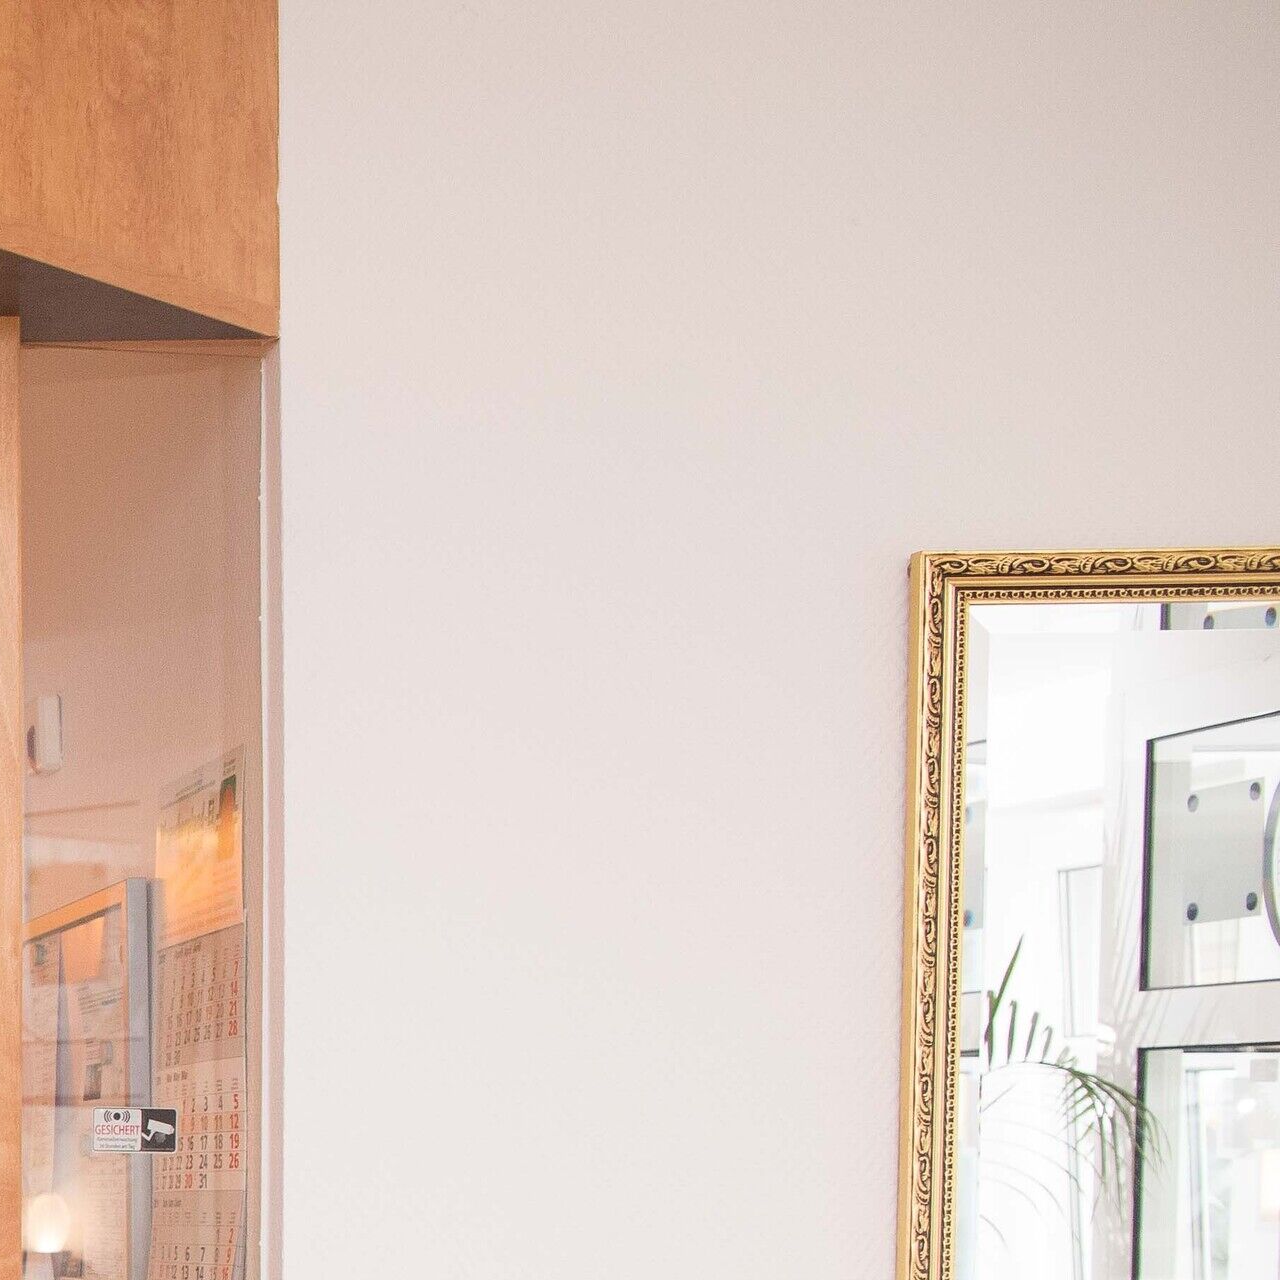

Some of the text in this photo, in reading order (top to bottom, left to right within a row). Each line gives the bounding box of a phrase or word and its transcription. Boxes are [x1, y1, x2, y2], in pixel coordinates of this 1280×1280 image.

[229, 1001, 237, 1016] 21
[228, 1020, 238, 1036] 28
[204, 1096, 208, 1111] 3
[233, 1094, 238, 1109] 5
[230, 1113, 239, 1128] 12
[95, 1124, 140, 1136] GESICHERT
[200, 1135, 208, 1150] 17
[214, 1134, 223, 1149] 18
[230, 1133, 239, 1149] 19
[186, 1155, 193, 1170] 23
[199, 1155, 208, 1169] 24
[214, 1154, 222, 1168] 25
[229, 1153, 239, 1168] 26
[199, 1174, 208, 1188] 31
[185, 1247, 190, 1261] 6
[201, 1247, 205, 1261] 7
[181, 1265, 189, 1280] 13
[196, 1266, 204, 1280] 14
